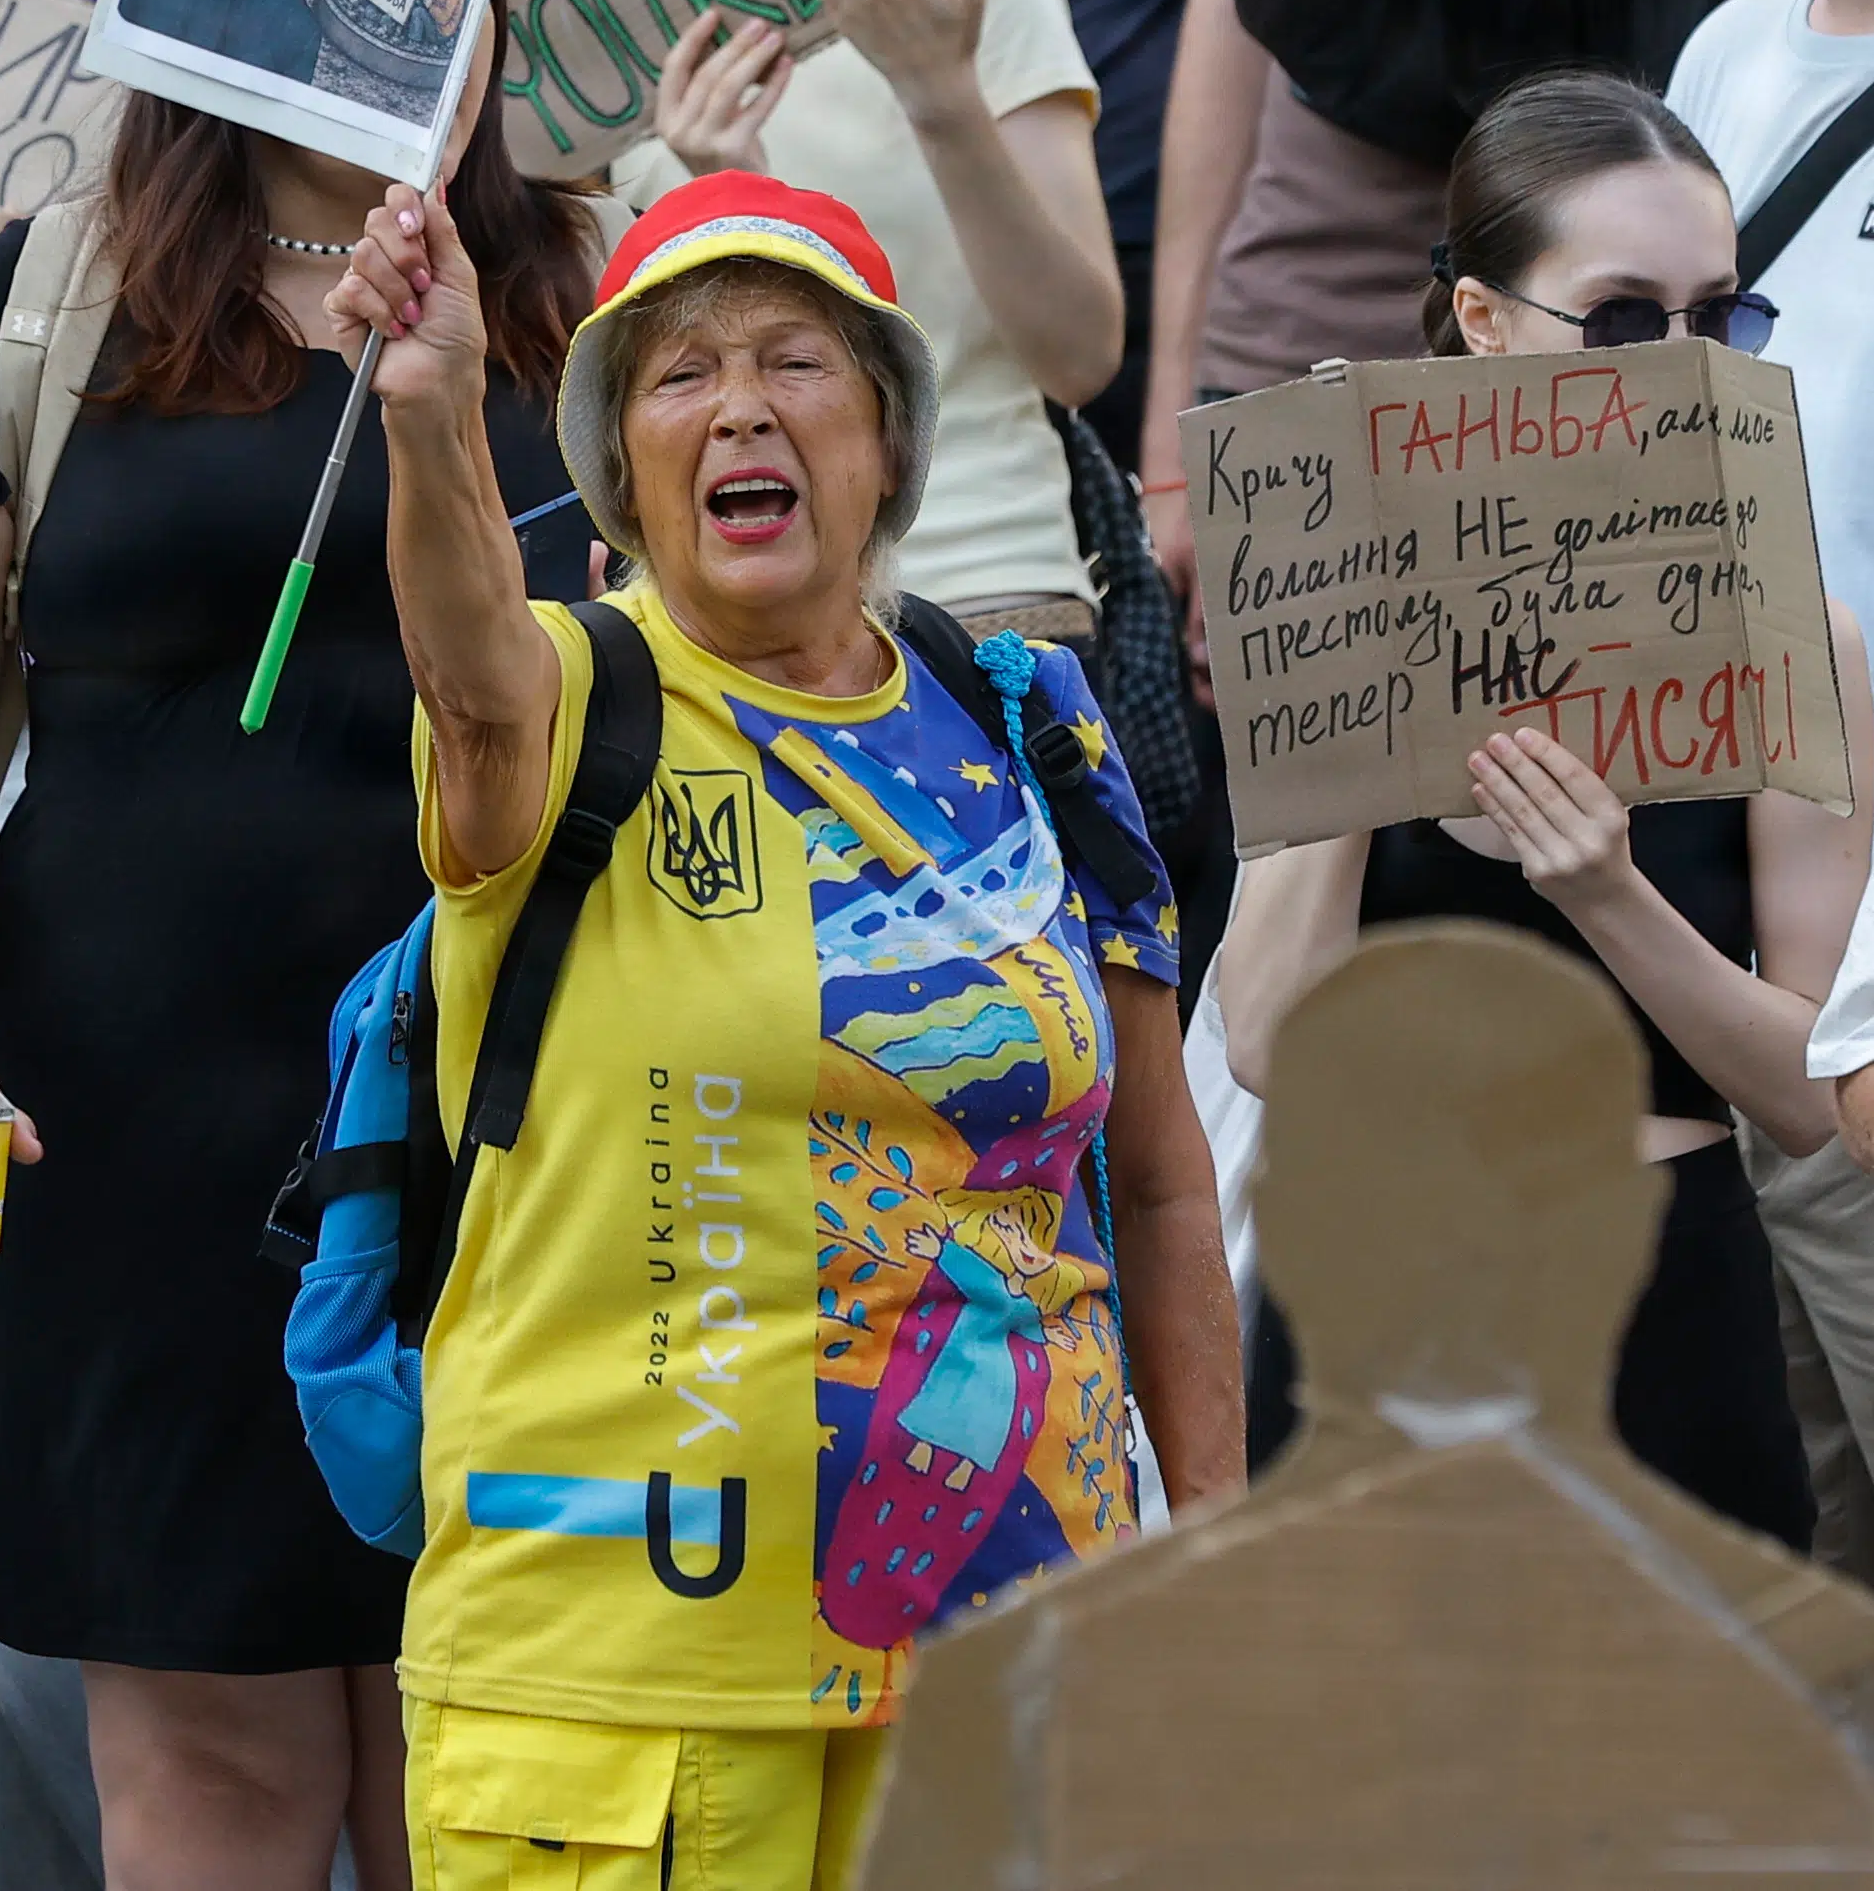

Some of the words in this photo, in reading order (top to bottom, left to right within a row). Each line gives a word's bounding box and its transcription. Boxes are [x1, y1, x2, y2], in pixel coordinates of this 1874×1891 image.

[1207, 425, 1335, 532] Кричу
[1227, 528, 1417, 617] волання
[1453, 496, 1534, 564] НЕ
[1553, 497, 1728, 585] долітає
[1477, 562, 1624, 657] була
[1246, 670, 1415, 769] тепер
[1451, 626, 1583, 714] НАС
[646, 1065, 678, 1285] Ukraina
[674, 1070, 761, 1450] Україна
[643, 1309, 671, 1388] 2022
